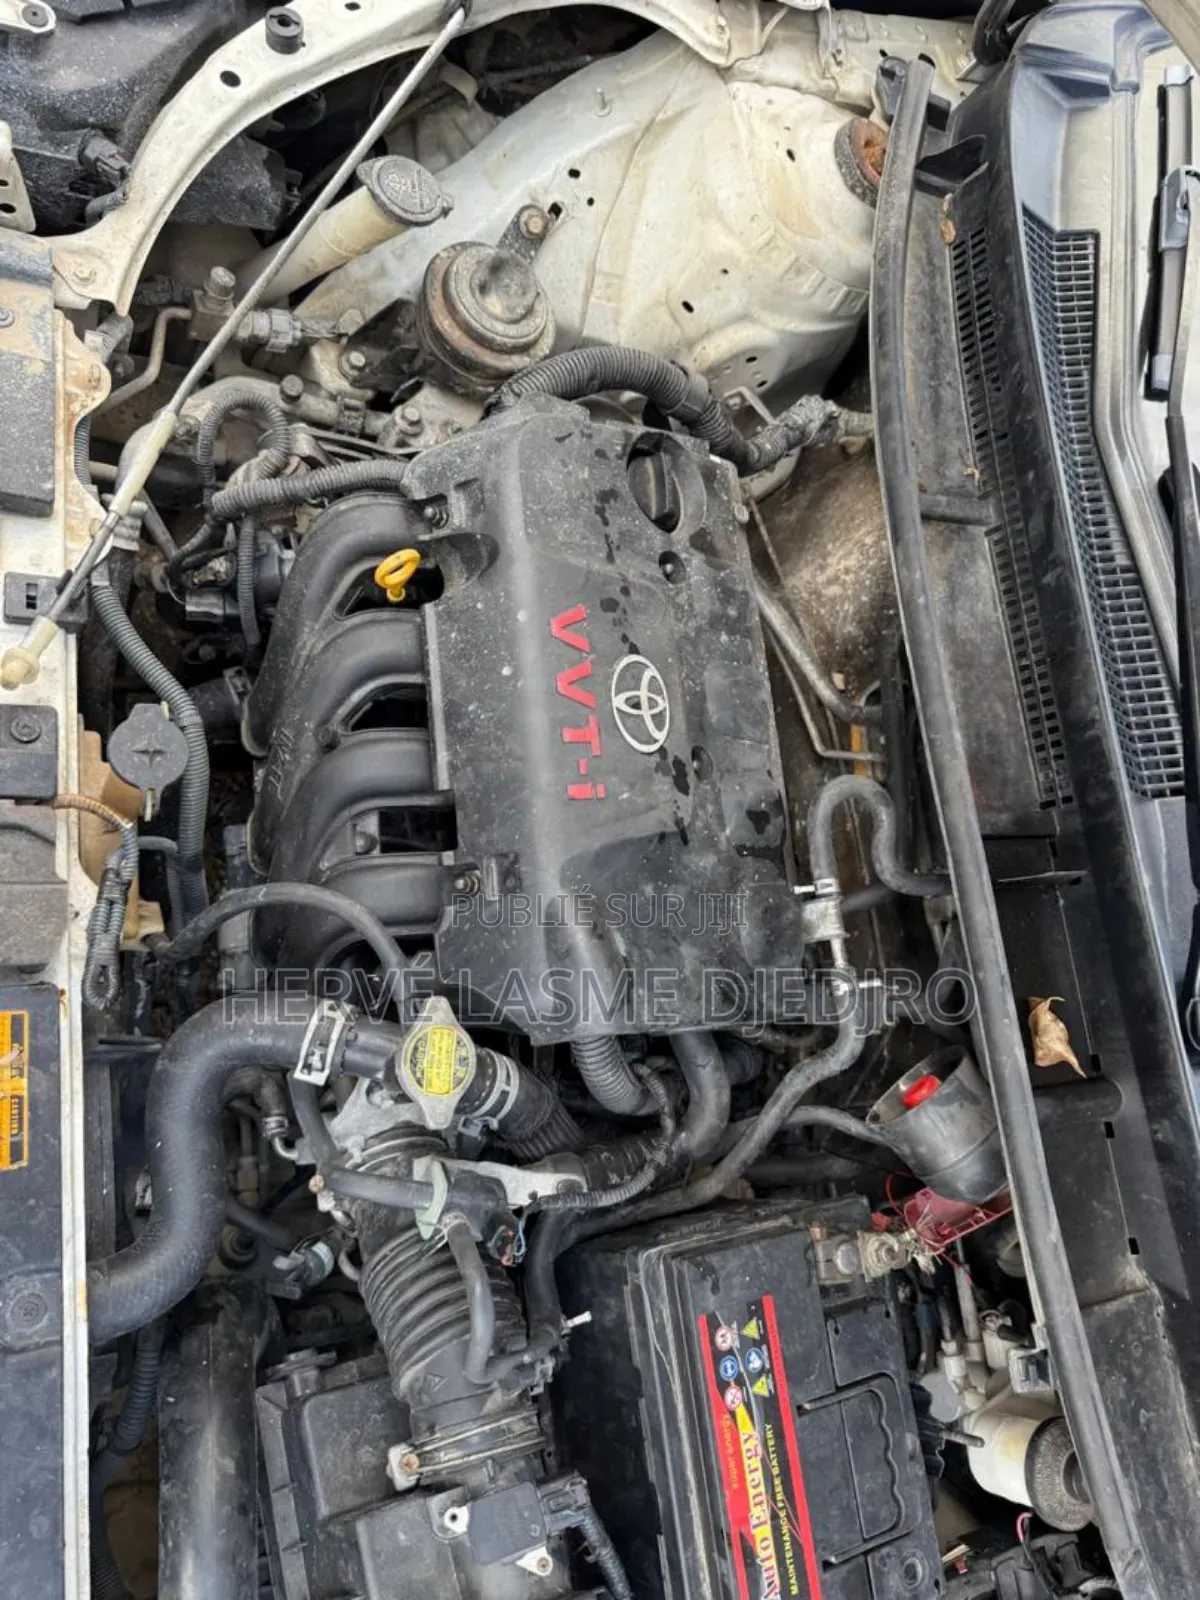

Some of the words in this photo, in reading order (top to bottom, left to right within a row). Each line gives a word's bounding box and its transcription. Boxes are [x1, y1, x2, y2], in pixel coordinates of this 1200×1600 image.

[549, 603, 607, 800] VVT-i
[741, 1431, 771, 1534] Energy
[764, 1423, 782, 1476] BATTERY
[773, 1475, 786, 1507] FREE
[756, 1535, 781, 1600] Auto
[778, 1508, 799, 1597] MAINTENANCE
